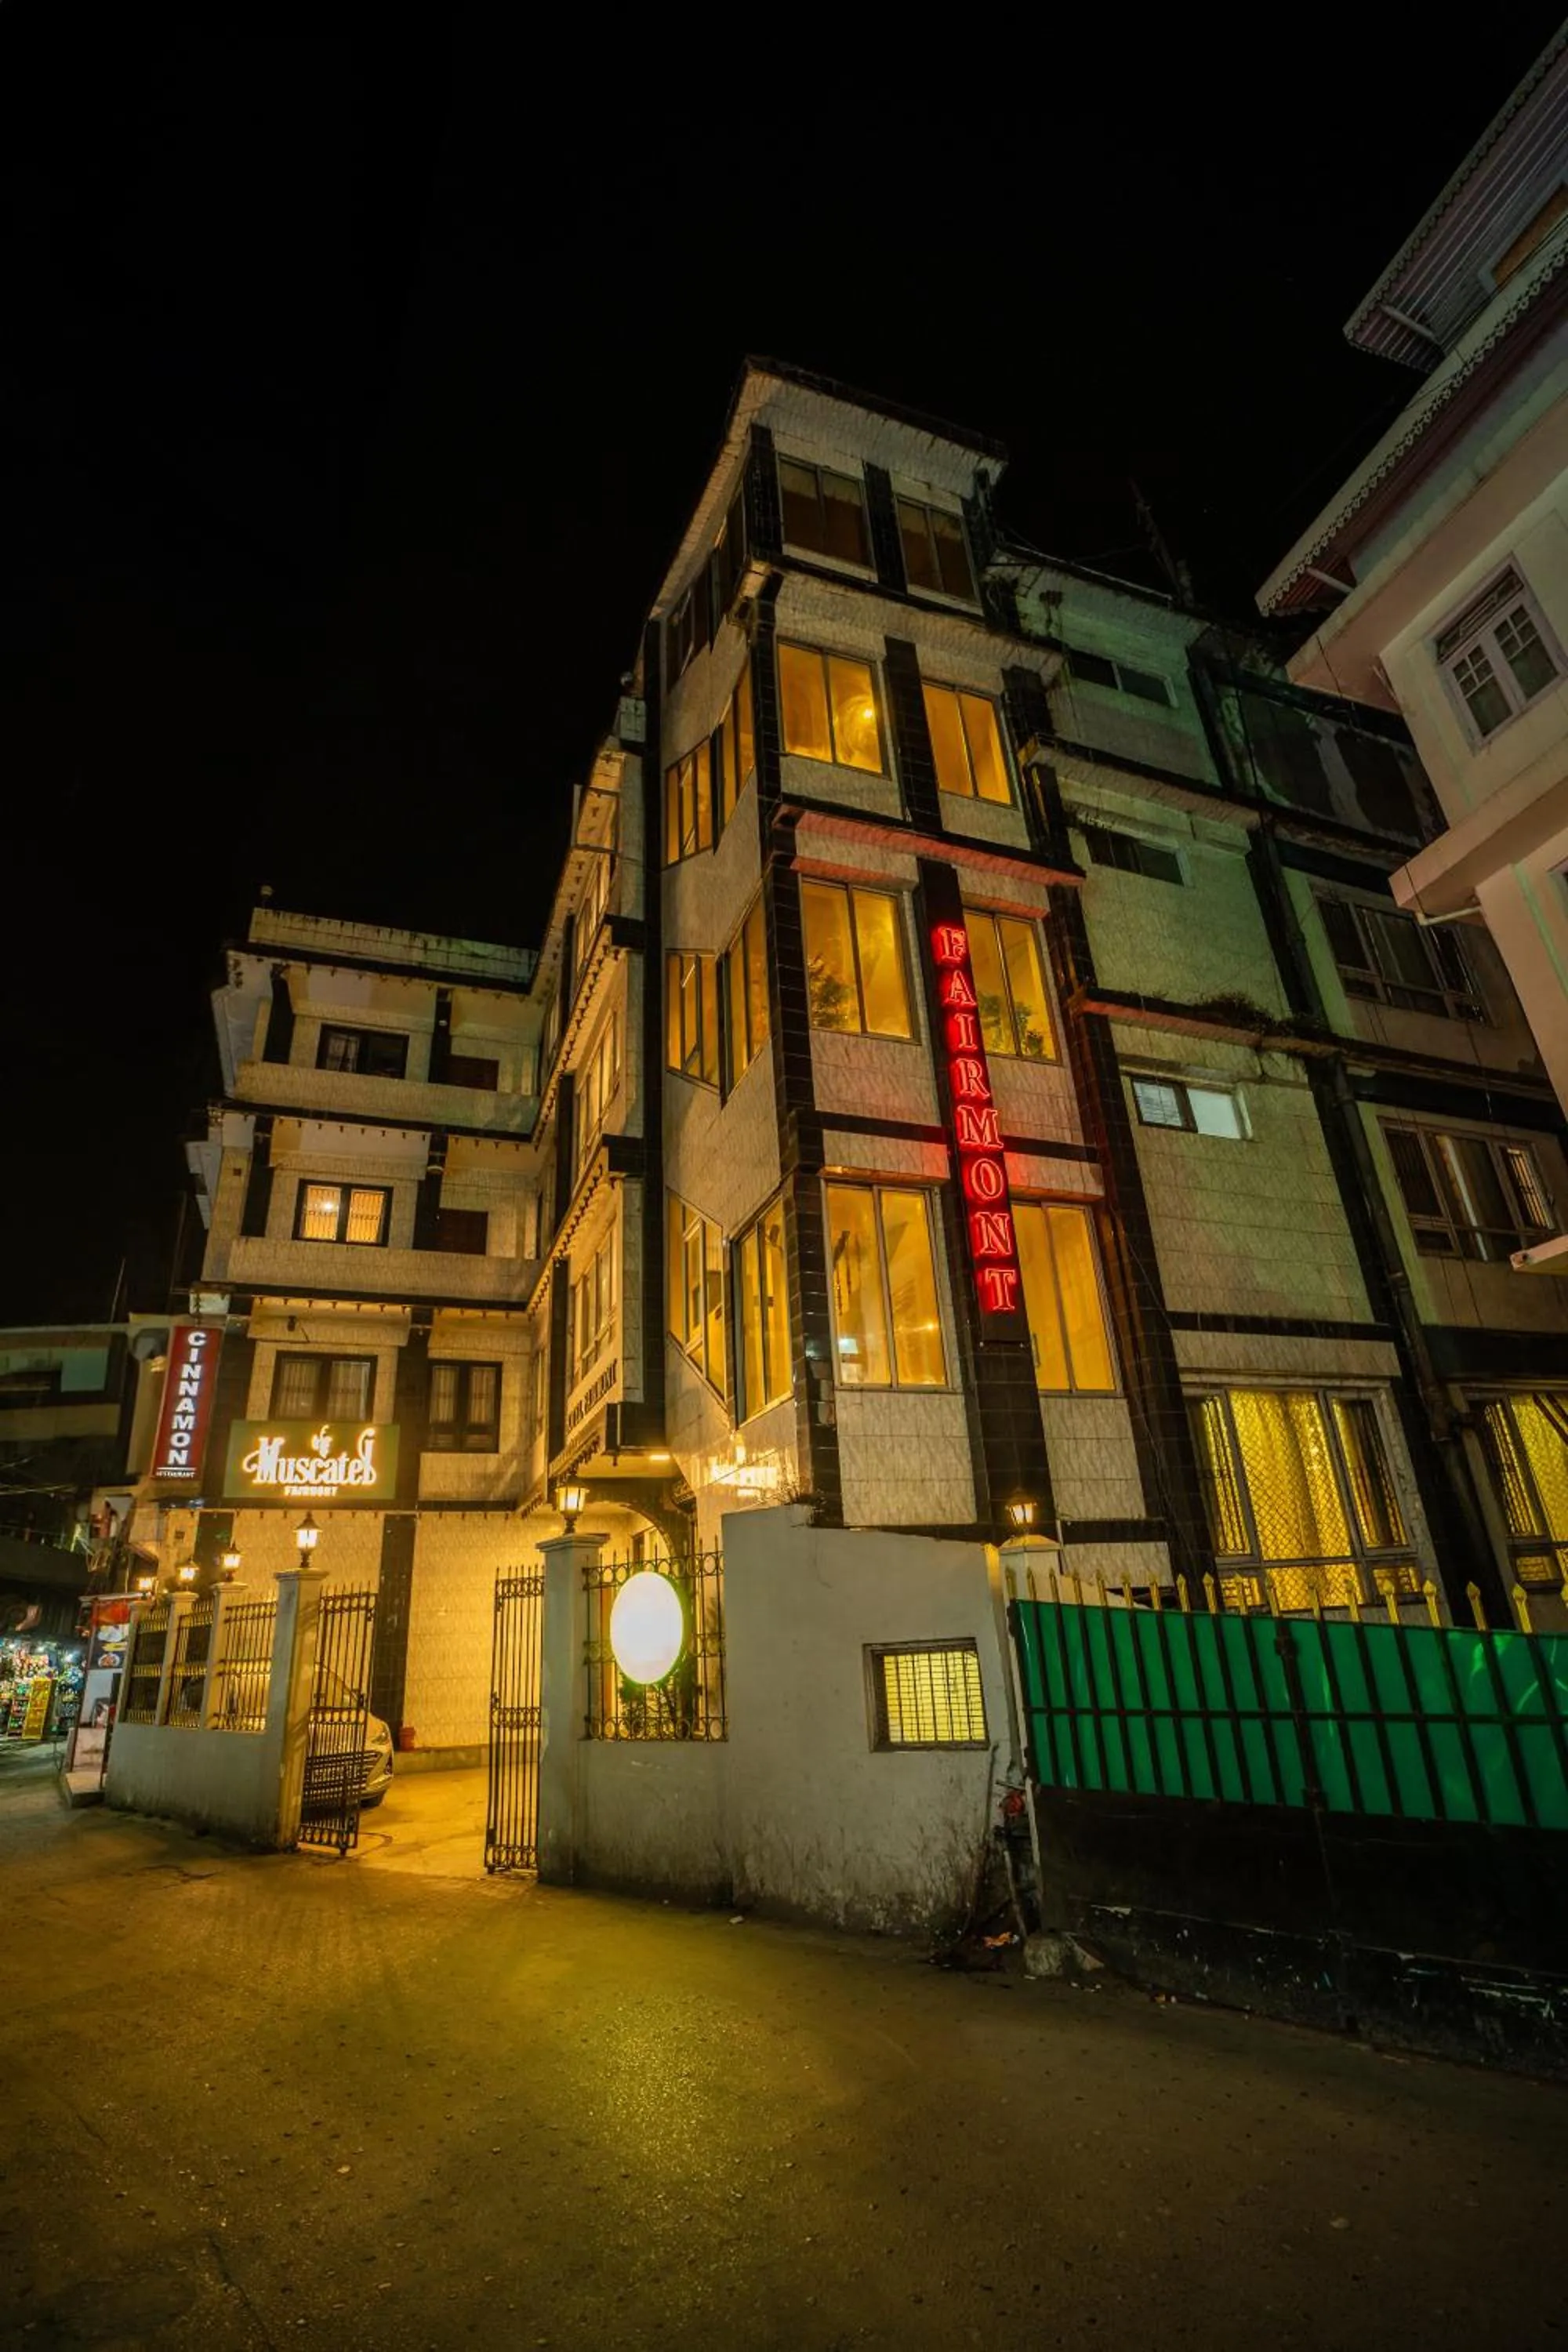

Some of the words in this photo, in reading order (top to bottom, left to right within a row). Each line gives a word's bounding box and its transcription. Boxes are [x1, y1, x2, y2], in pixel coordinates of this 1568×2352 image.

[934, 925, 1016, 1312] FAIRMONT
[167, 1331, 207, 1465] CINNAMON
[242, 1427, 377, 1485] Muscatel
